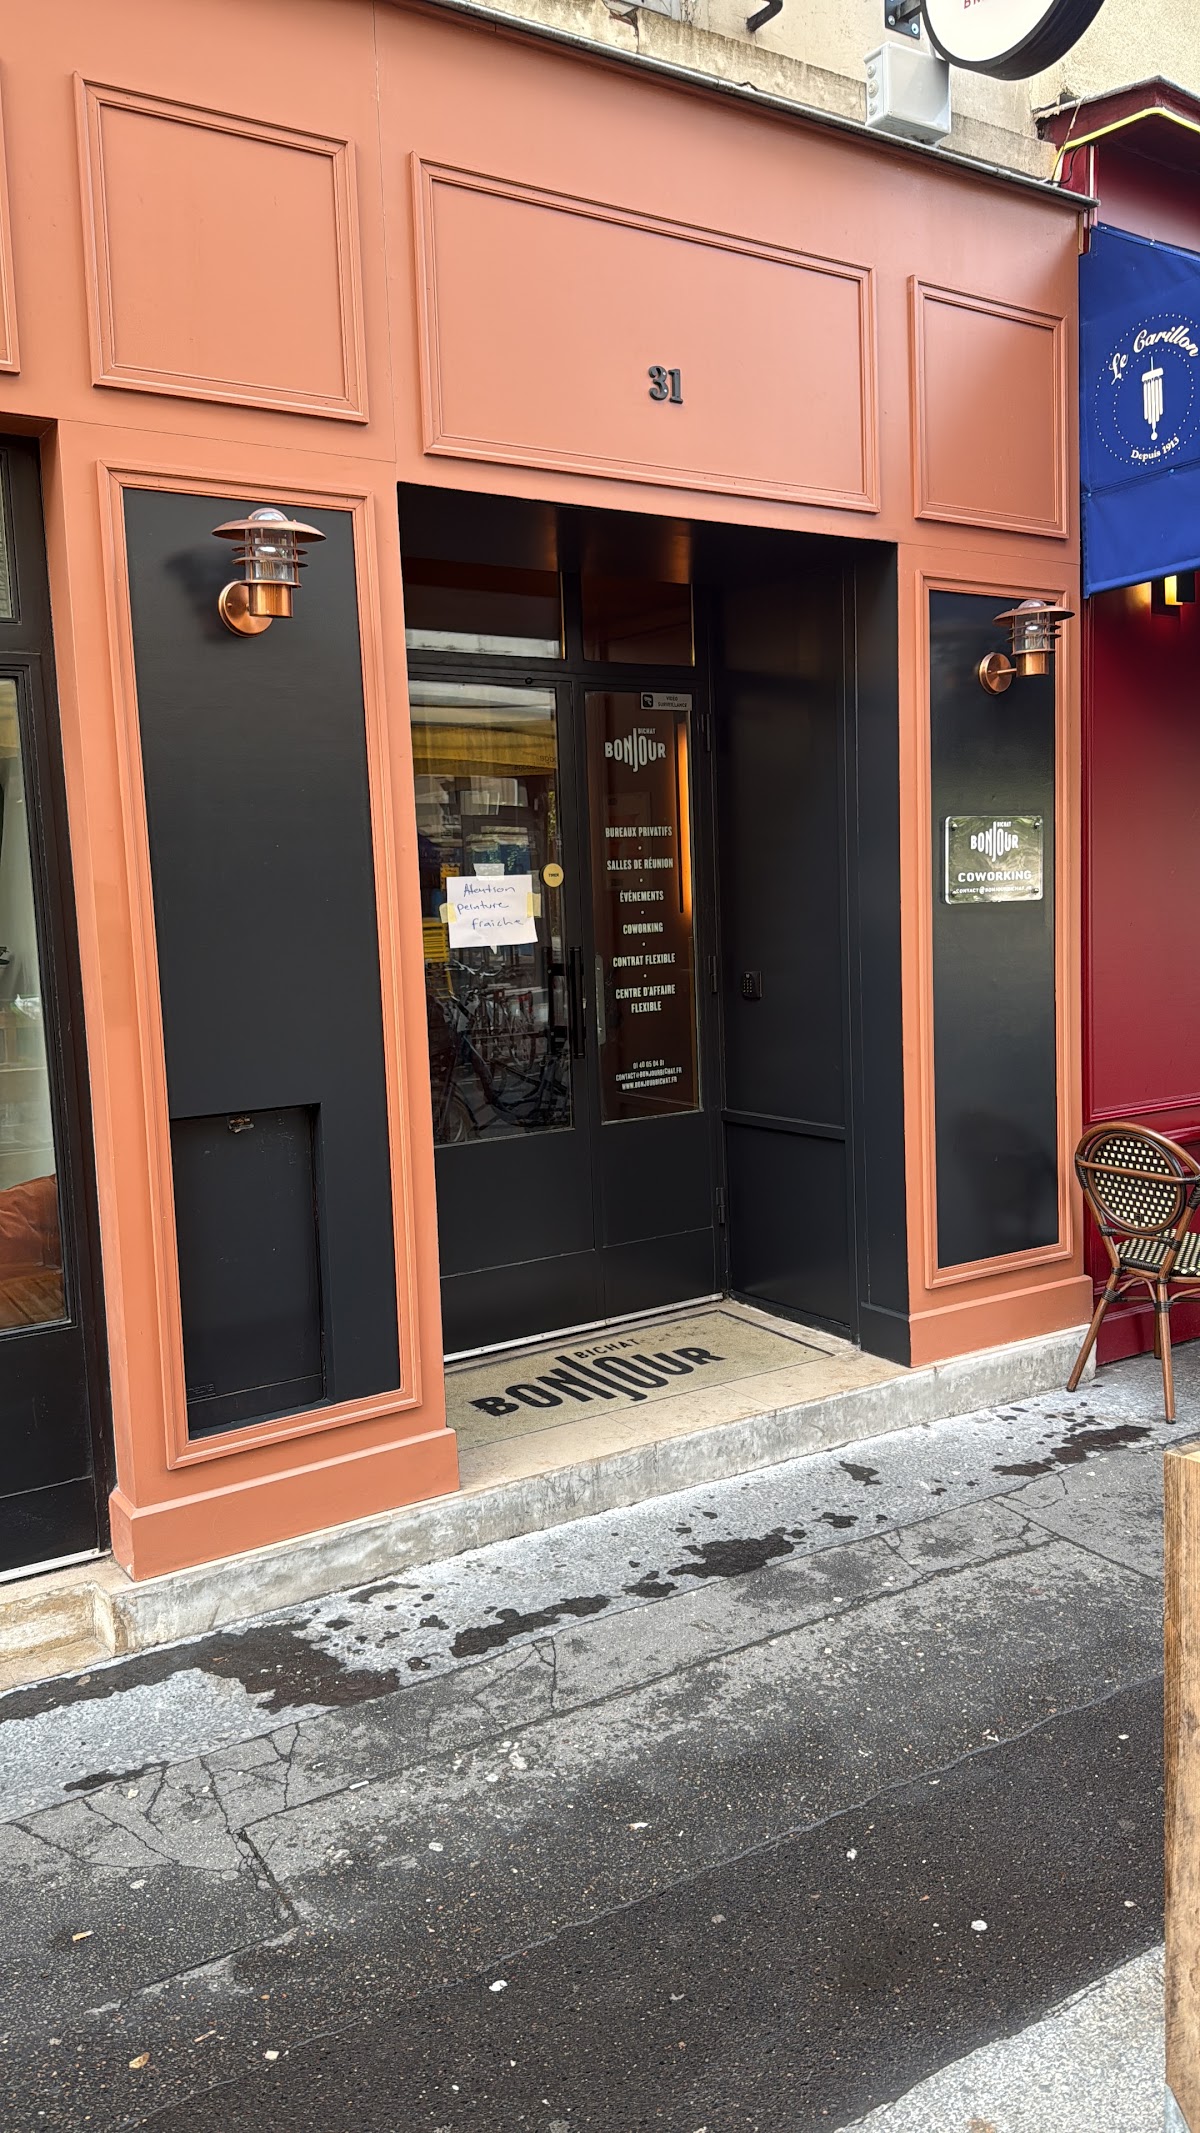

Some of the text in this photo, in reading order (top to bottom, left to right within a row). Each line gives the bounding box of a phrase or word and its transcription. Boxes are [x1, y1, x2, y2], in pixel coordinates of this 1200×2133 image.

[1108, 325, 1199, 385] Le Carillon
[648, 365, 684, 405] 31
[1130, 436, 1180, 462] Depuis 1913
[637, 727, 656, 735] BICHAT
[604, 728, 667, 772] BONJOUR
[605, 826, 673, 838] BUREAUX PRIVATIFS
[970, 821, 1019, 862] BONJOUR
[606, 857, 674, 871] SALLES DE RÉUNION
[957, 870, 1032, 883] COWORKING
[619, 889, 664, 903] ÉVÉNEMENTS
[456, 900, 510, 915] peinture
[622, 922, 664, 935] COWORKING
[612, 953, 676, 967] CONTRAT FLEXIBLE
[615, 984, 676, 999] CENTRE D'AFFAIRE
[630, 1001, 662, 1013] FLEXIBLE
[574, 1338, 640, 1359] BICHAT
[468, 1347, 726, 1417] BONJOUR
